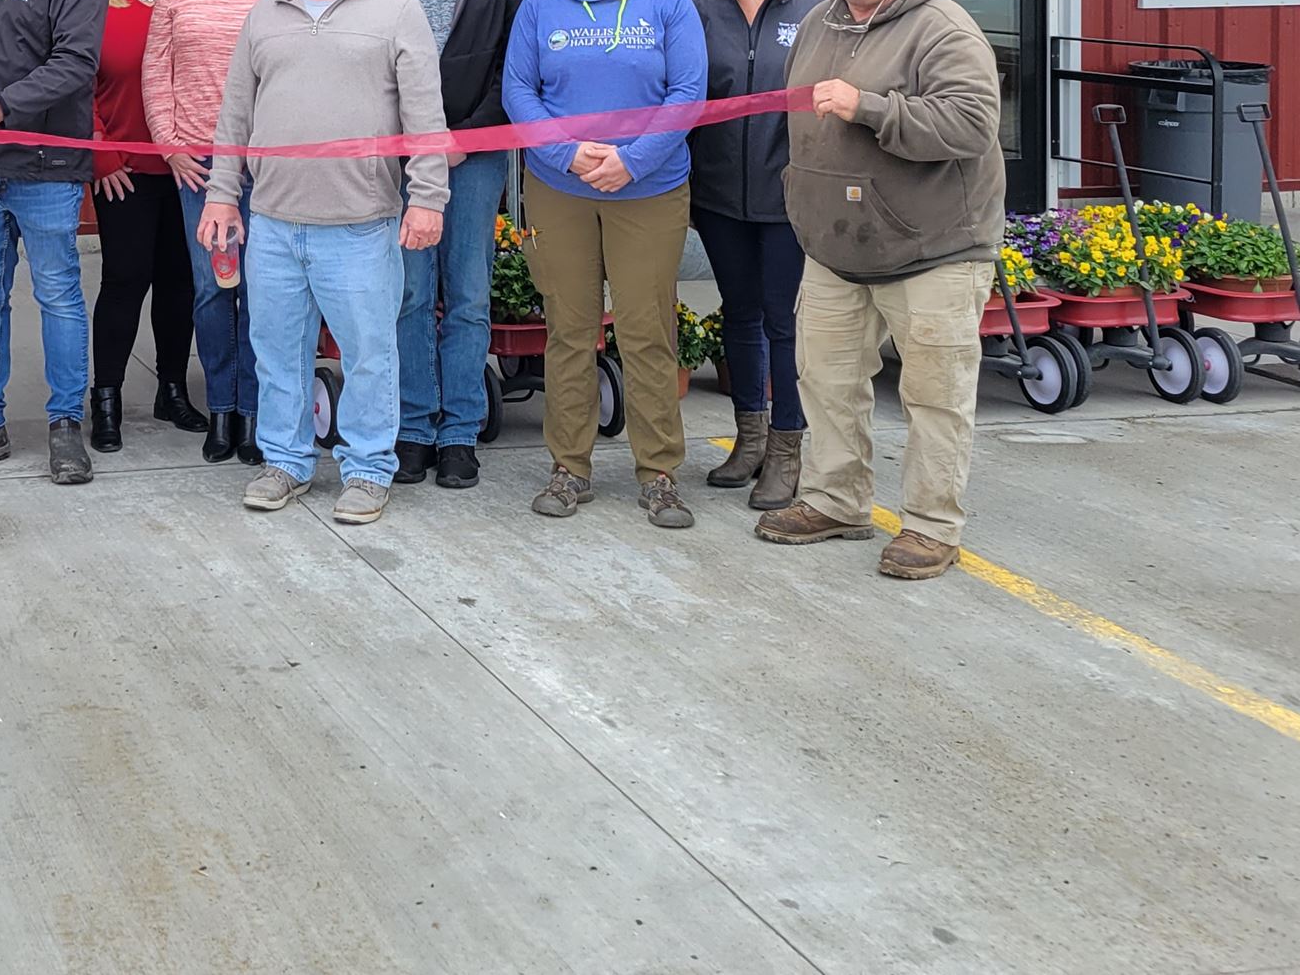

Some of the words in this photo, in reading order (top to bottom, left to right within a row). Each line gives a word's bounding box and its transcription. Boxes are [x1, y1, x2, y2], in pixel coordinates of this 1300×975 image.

[570, 28, 614, 37] WALLIS
[619, 26, 655, 35] SANDS
[570, 39, 596, 47] HALF
